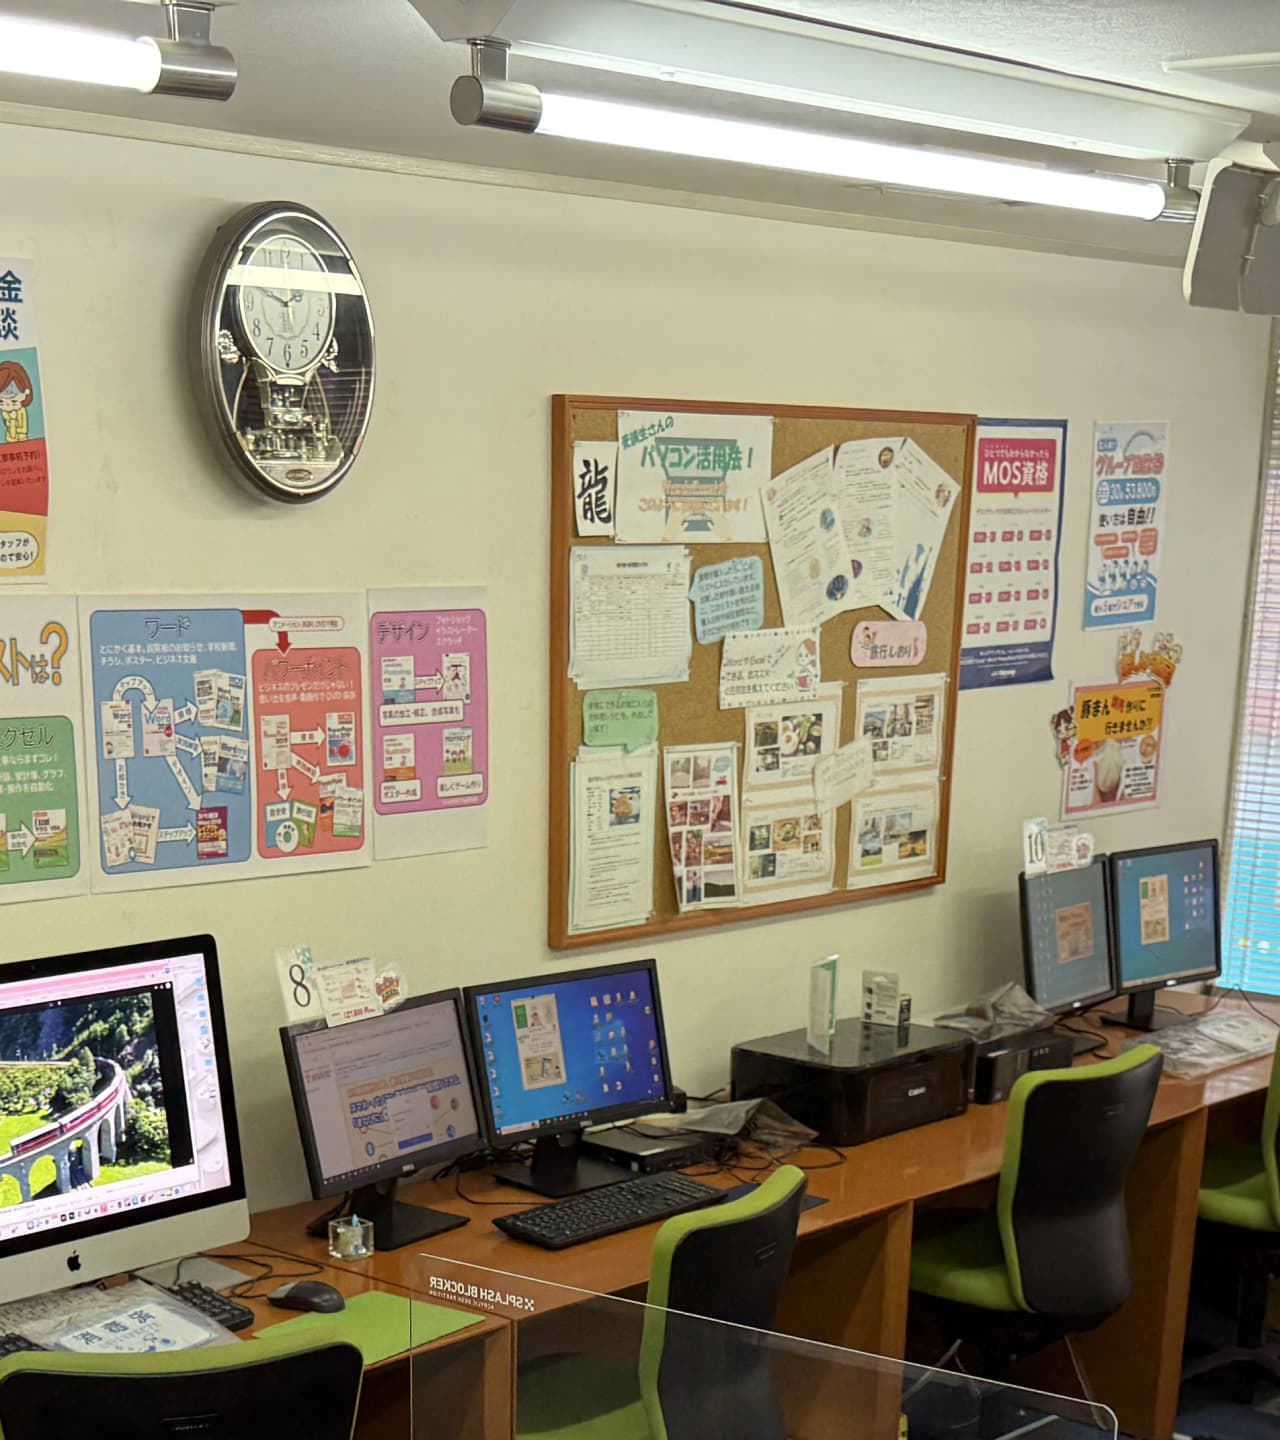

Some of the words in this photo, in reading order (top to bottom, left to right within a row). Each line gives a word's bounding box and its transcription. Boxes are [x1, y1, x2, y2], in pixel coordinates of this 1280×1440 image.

[983, 460, 1049, 487] MOS資格
[577, 458, 613, 525] 龍
[144, 616, 191, 639] ワード
[376, 621, 430, 644] デザイン
[1027, 832, 1046, 865] 10
[288, 963, 312, 1009] 8
